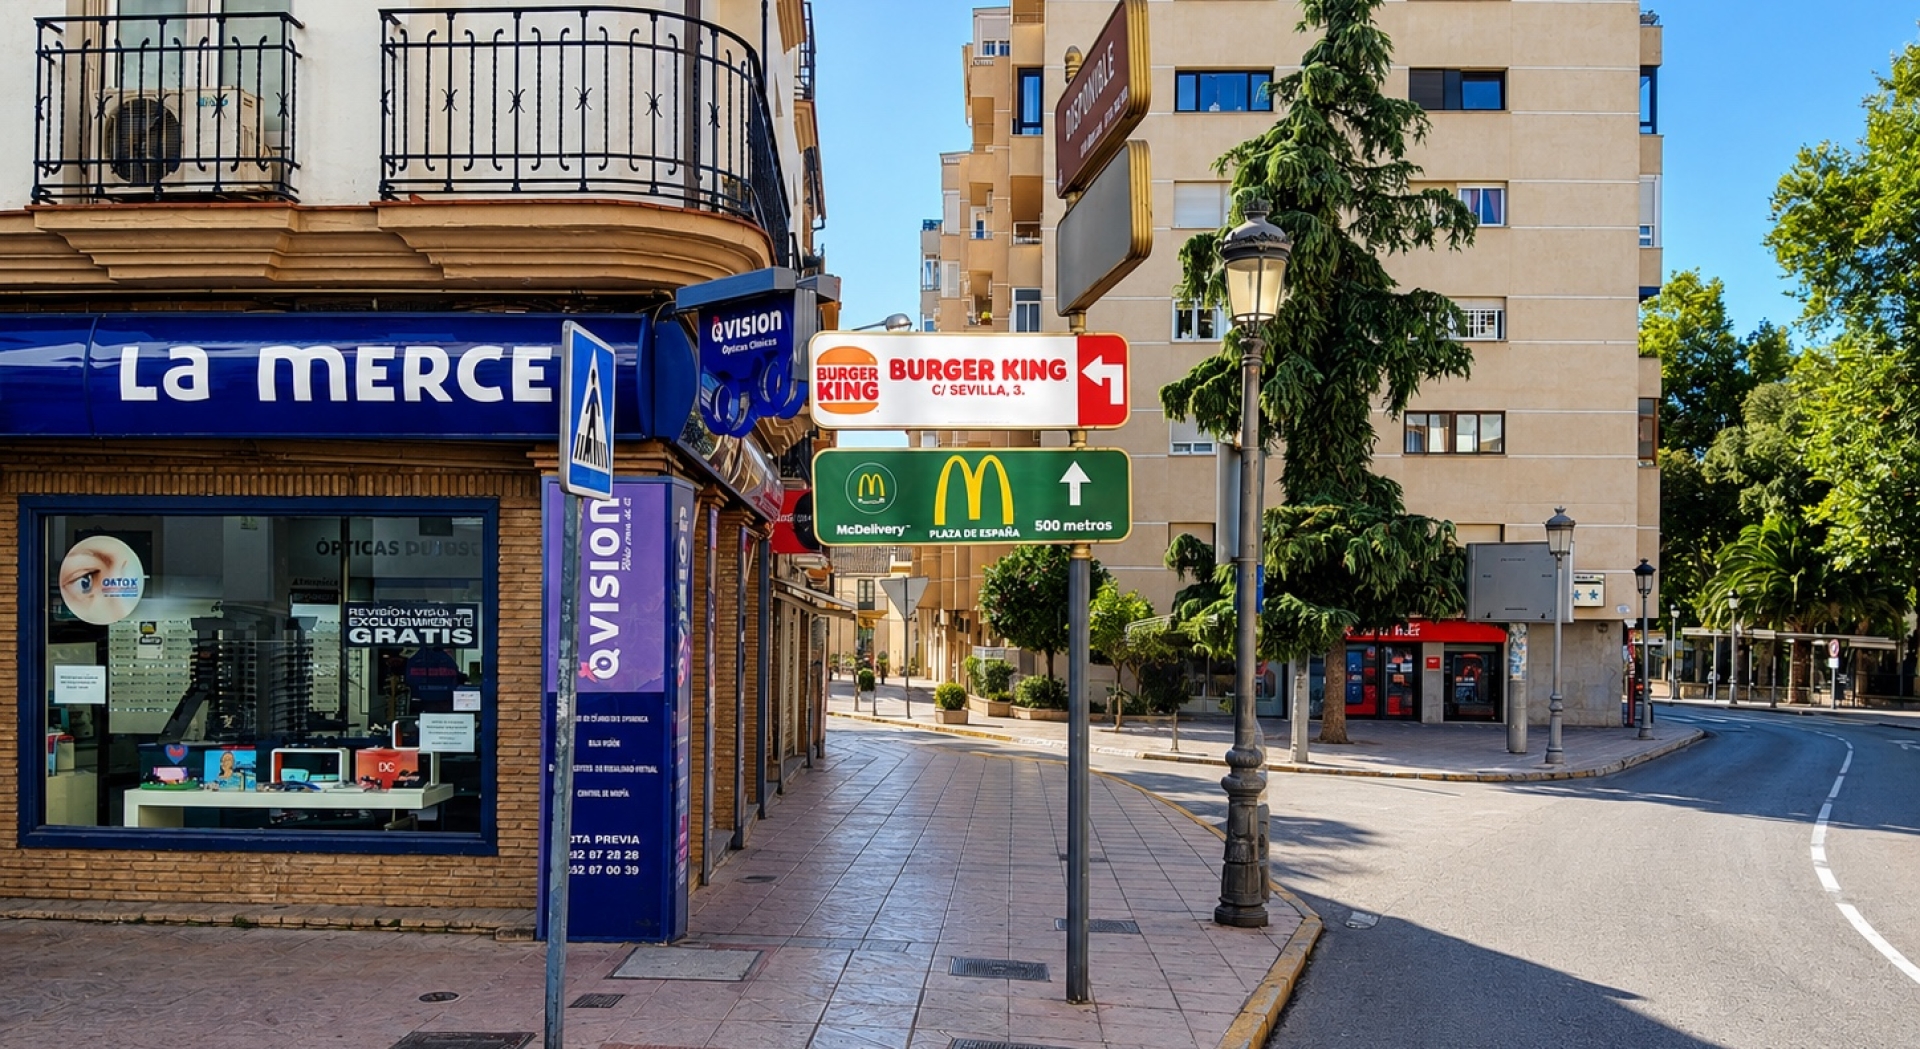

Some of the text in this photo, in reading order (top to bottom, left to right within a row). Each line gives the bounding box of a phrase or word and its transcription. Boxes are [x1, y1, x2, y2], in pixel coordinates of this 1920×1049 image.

[816, 367, 879, 380] BURGER
[889, 358, 1067, 381] BURGER KING
[816, 382, 879, 401] KING
[931, 384, 1026, 397] C/ SEVILLA, 3.
[929, 526, 1021, 539] PLAZA DE ESPAÑA
[1034, 520, 1112, 532] 500 metros
[348, 628, 473, 644] GRATIS
[595, 835, 640, 844] PREVIA
[606, 865, 621, 875] 00
[624, 865, 639, 875] 39
